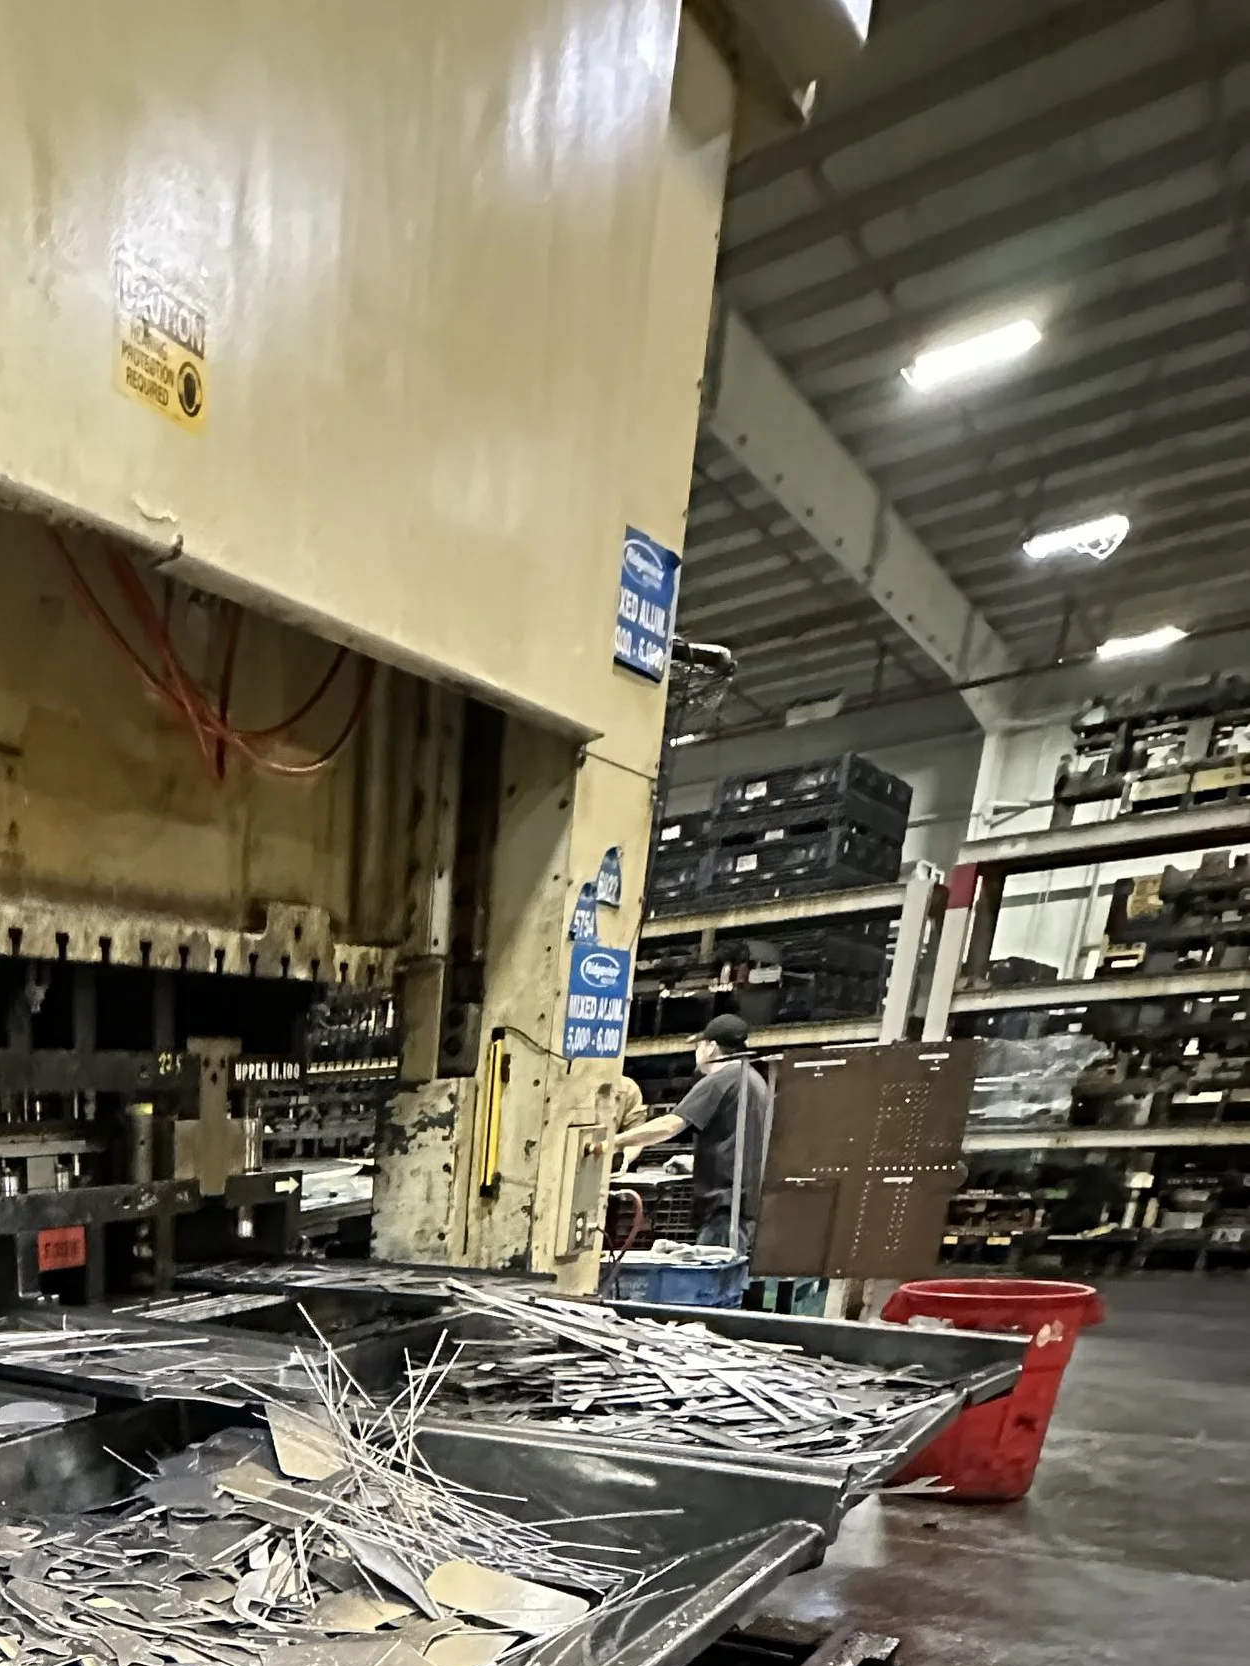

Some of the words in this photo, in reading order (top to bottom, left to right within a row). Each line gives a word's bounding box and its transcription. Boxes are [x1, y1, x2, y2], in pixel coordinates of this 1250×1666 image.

[126, 365, 169, 407] REQUIRED
[568, 993, 597, 1021] MIXED
[234, 1062, 268, 1081] UPPER
